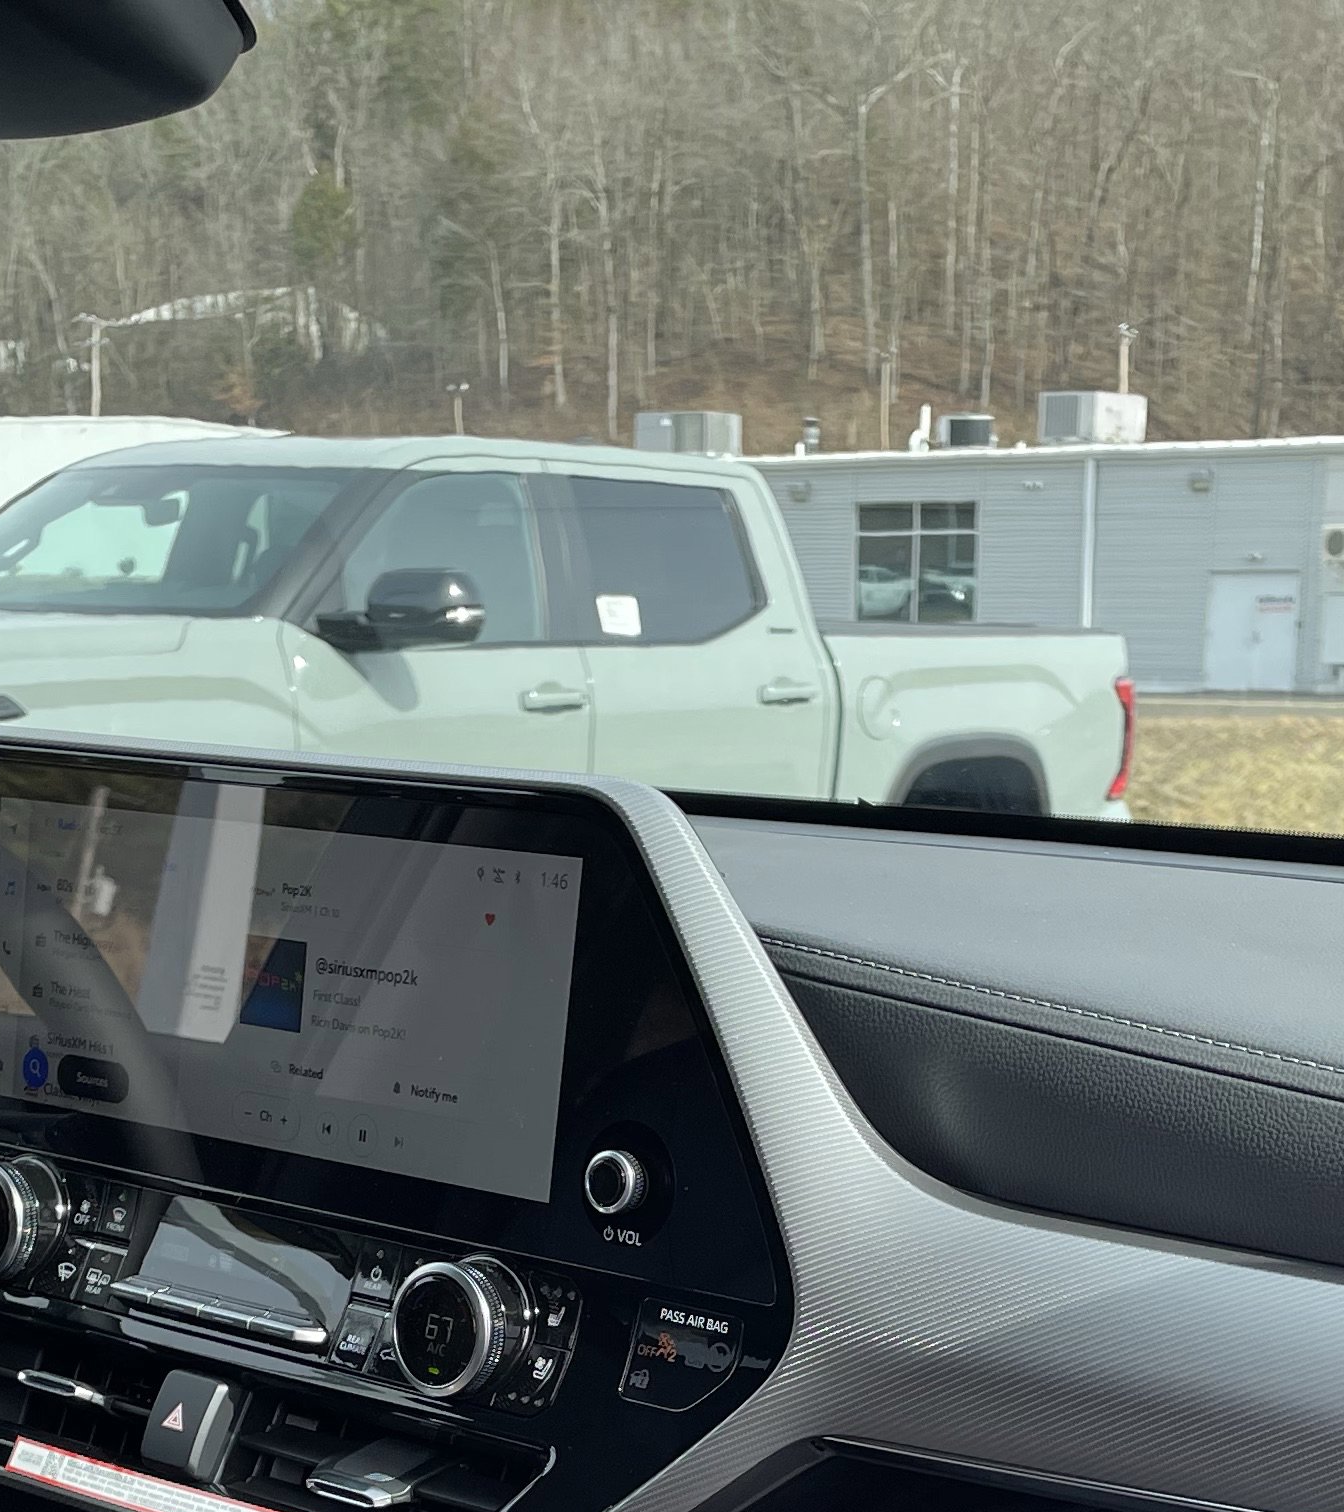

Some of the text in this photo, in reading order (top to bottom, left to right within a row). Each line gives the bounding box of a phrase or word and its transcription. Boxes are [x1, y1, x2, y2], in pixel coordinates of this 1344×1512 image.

[542, 871, 568, 891] 1:46
[282, 883, 313, 899] Pop2K
[315, 957, 418, 988] @siriusxmpop2k
[289, 1063, 324, 1081] Related
[410, 1083, 459, 1104] Notify me
[260, 1110, 272, 1123] Ch
[617, 1228, 642, 1246] VOL
[425, 1313, 454, 1344] 67
[660, 1307, 729, 1335] PASS AIR BAG
[426, 1343, 446, 1357] A/C
